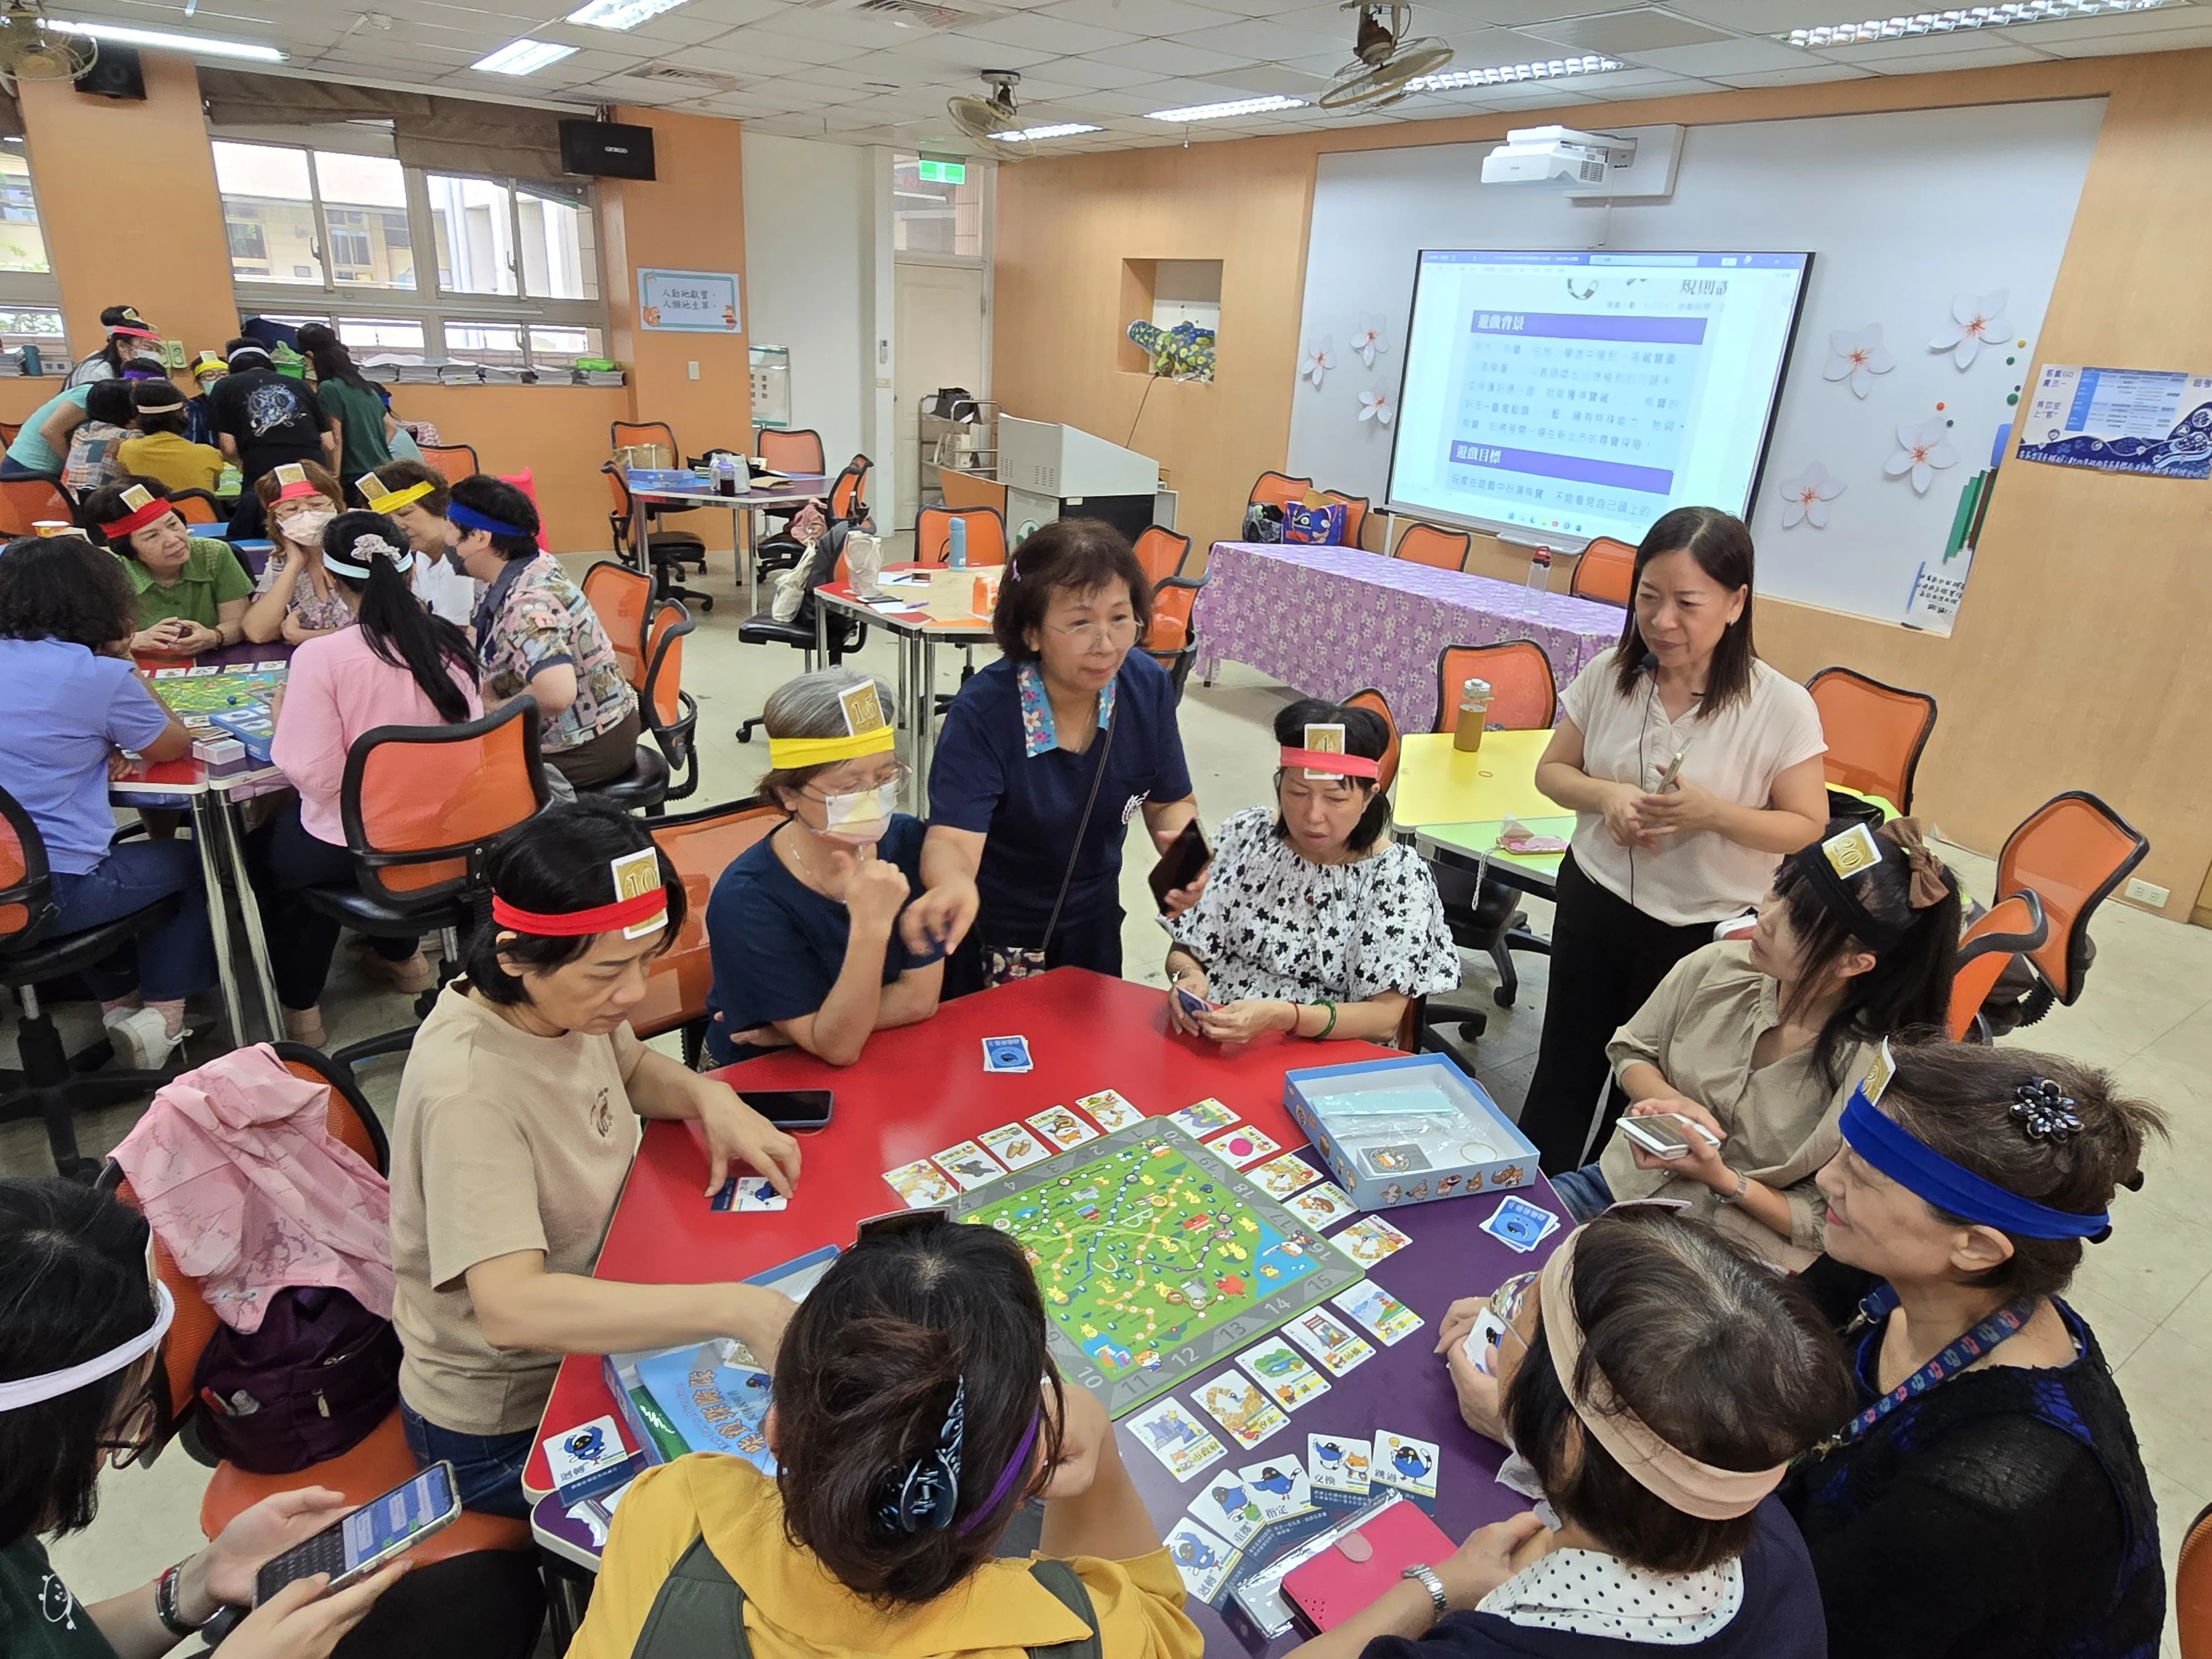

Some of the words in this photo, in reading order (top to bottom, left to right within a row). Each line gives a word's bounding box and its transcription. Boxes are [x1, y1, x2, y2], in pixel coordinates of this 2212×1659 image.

[1477, 314, 1525, 331] 遊戲背景
[1455, 444, 1503, 465] 遊戲目標
[850, 698, 878, 726] 15
[626, 866, 659, 898] 10
[1164, 1129, 1187, 1146] 20
[1089, 1145, 1106, 1156] 2
[1198, 1156, 1220, 1175] 19
[1232, 1182, 1255, 1199] 18
[1268, 1208, 1293, 1229] 17
[1307, 1241, 1333, 1261] 16
[1307, 1272, 1333, 1292] 15
[1264, 1296, 1291, 1316] 14
[1219, 1322, 1248, 1343] 13
[1170, 1346, 1201, 1368] 12
[1077, 1365, 1104, 1389] 10
[1120, 1374, 1151, 1395] 11
[688, 1369, 768, 1455] 柴寶探險隊
[1313, 1473, 1336, 1487] 交換
[1374, 1468, 1397, 1483] 跳過
[1264, 1505, 1289, 1520] 指定
